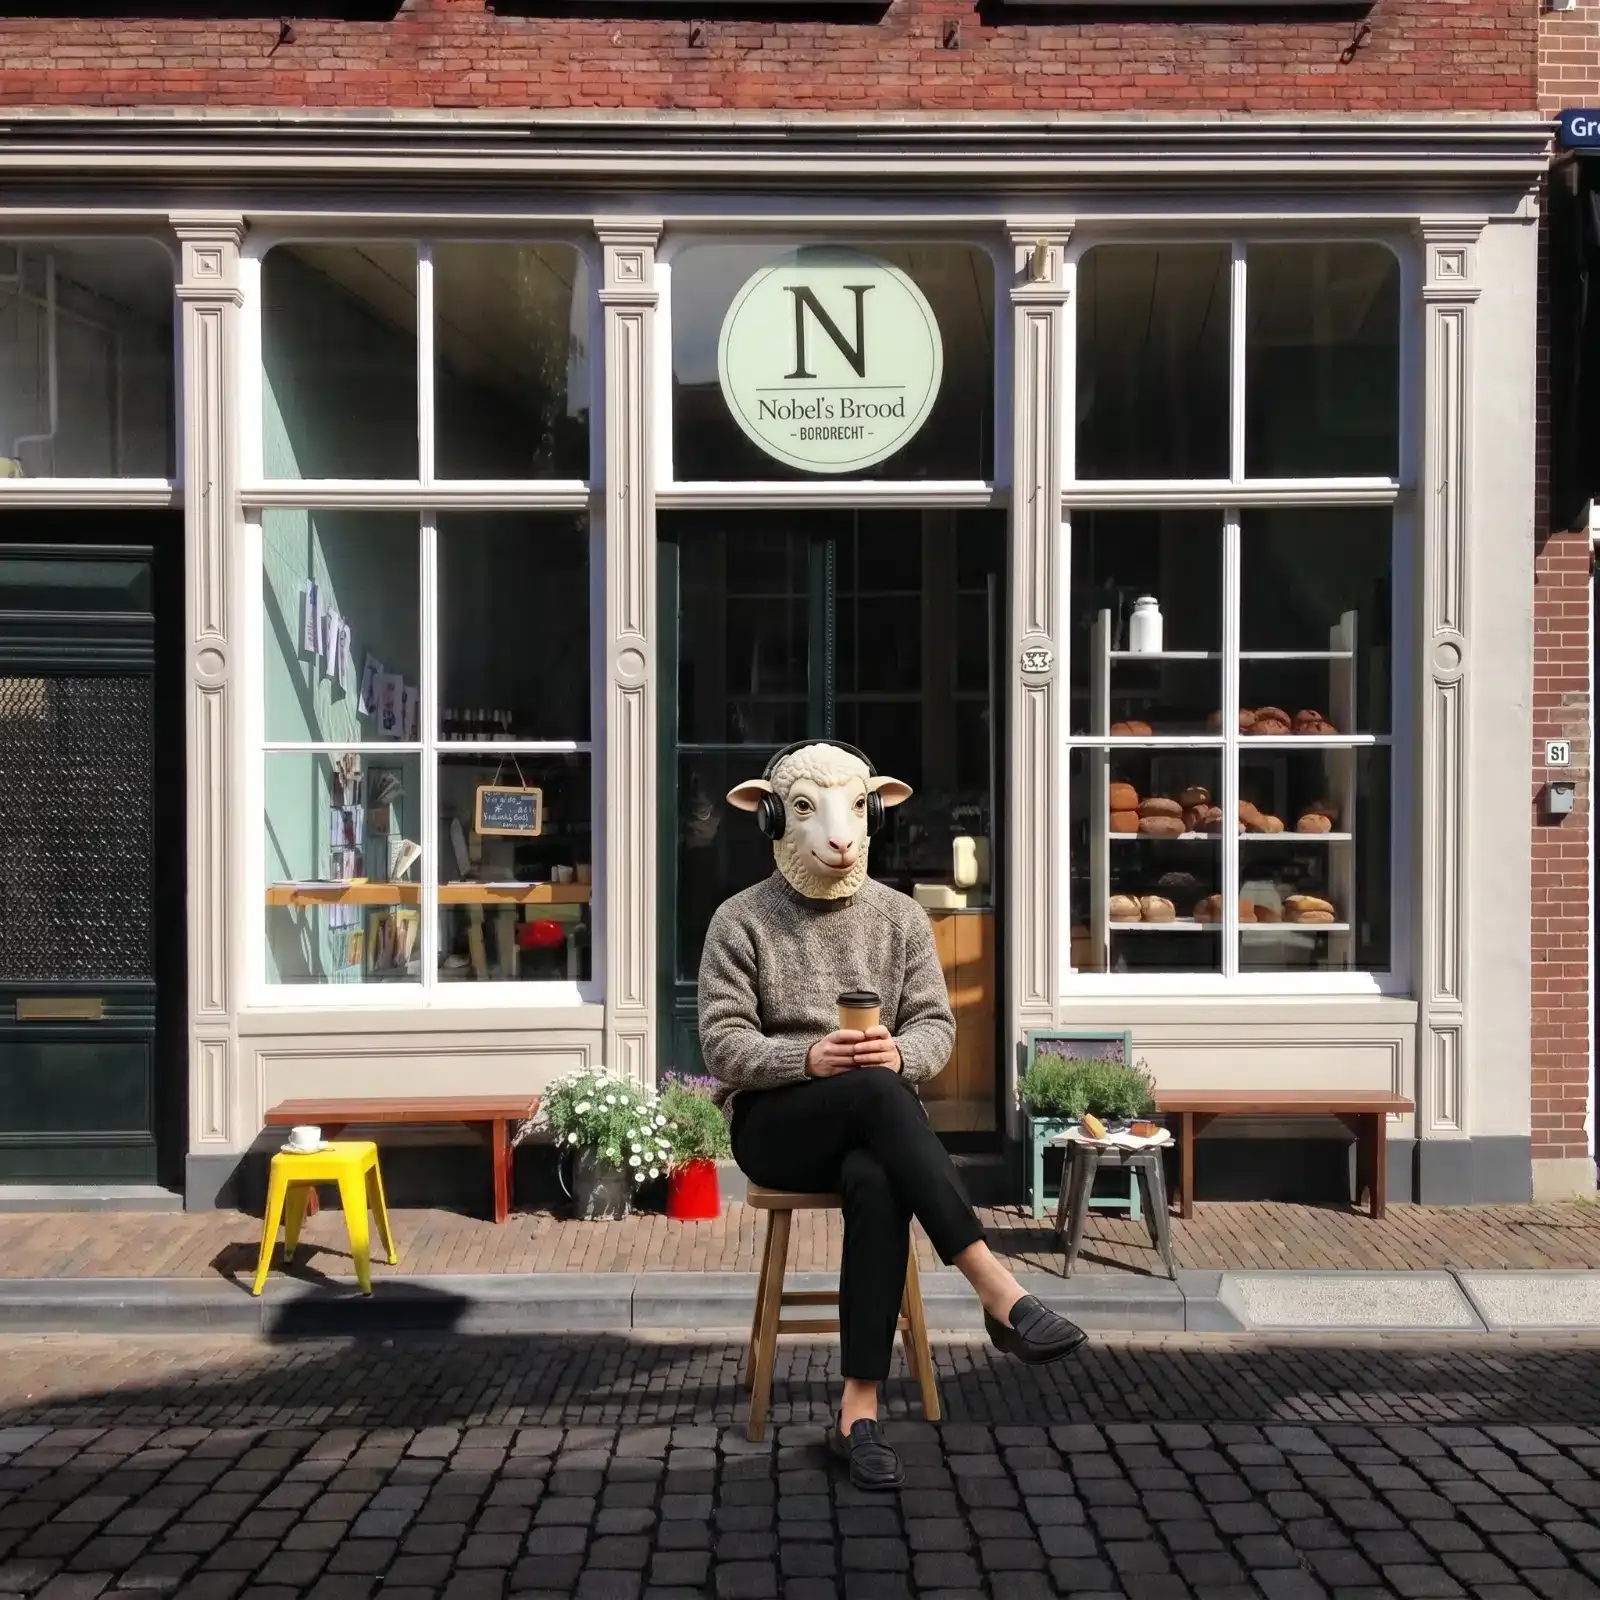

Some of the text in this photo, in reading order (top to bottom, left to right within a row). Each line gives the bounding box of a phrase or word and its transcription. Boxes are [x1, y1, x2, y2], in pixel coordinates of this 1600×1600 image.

[783, 284, 876, 380] N
[758, 396, 906, 421] Nobel's Brood
[800, 426, 864, 441] BORDRECHT
[1551, 746, 1565, 761] S1
